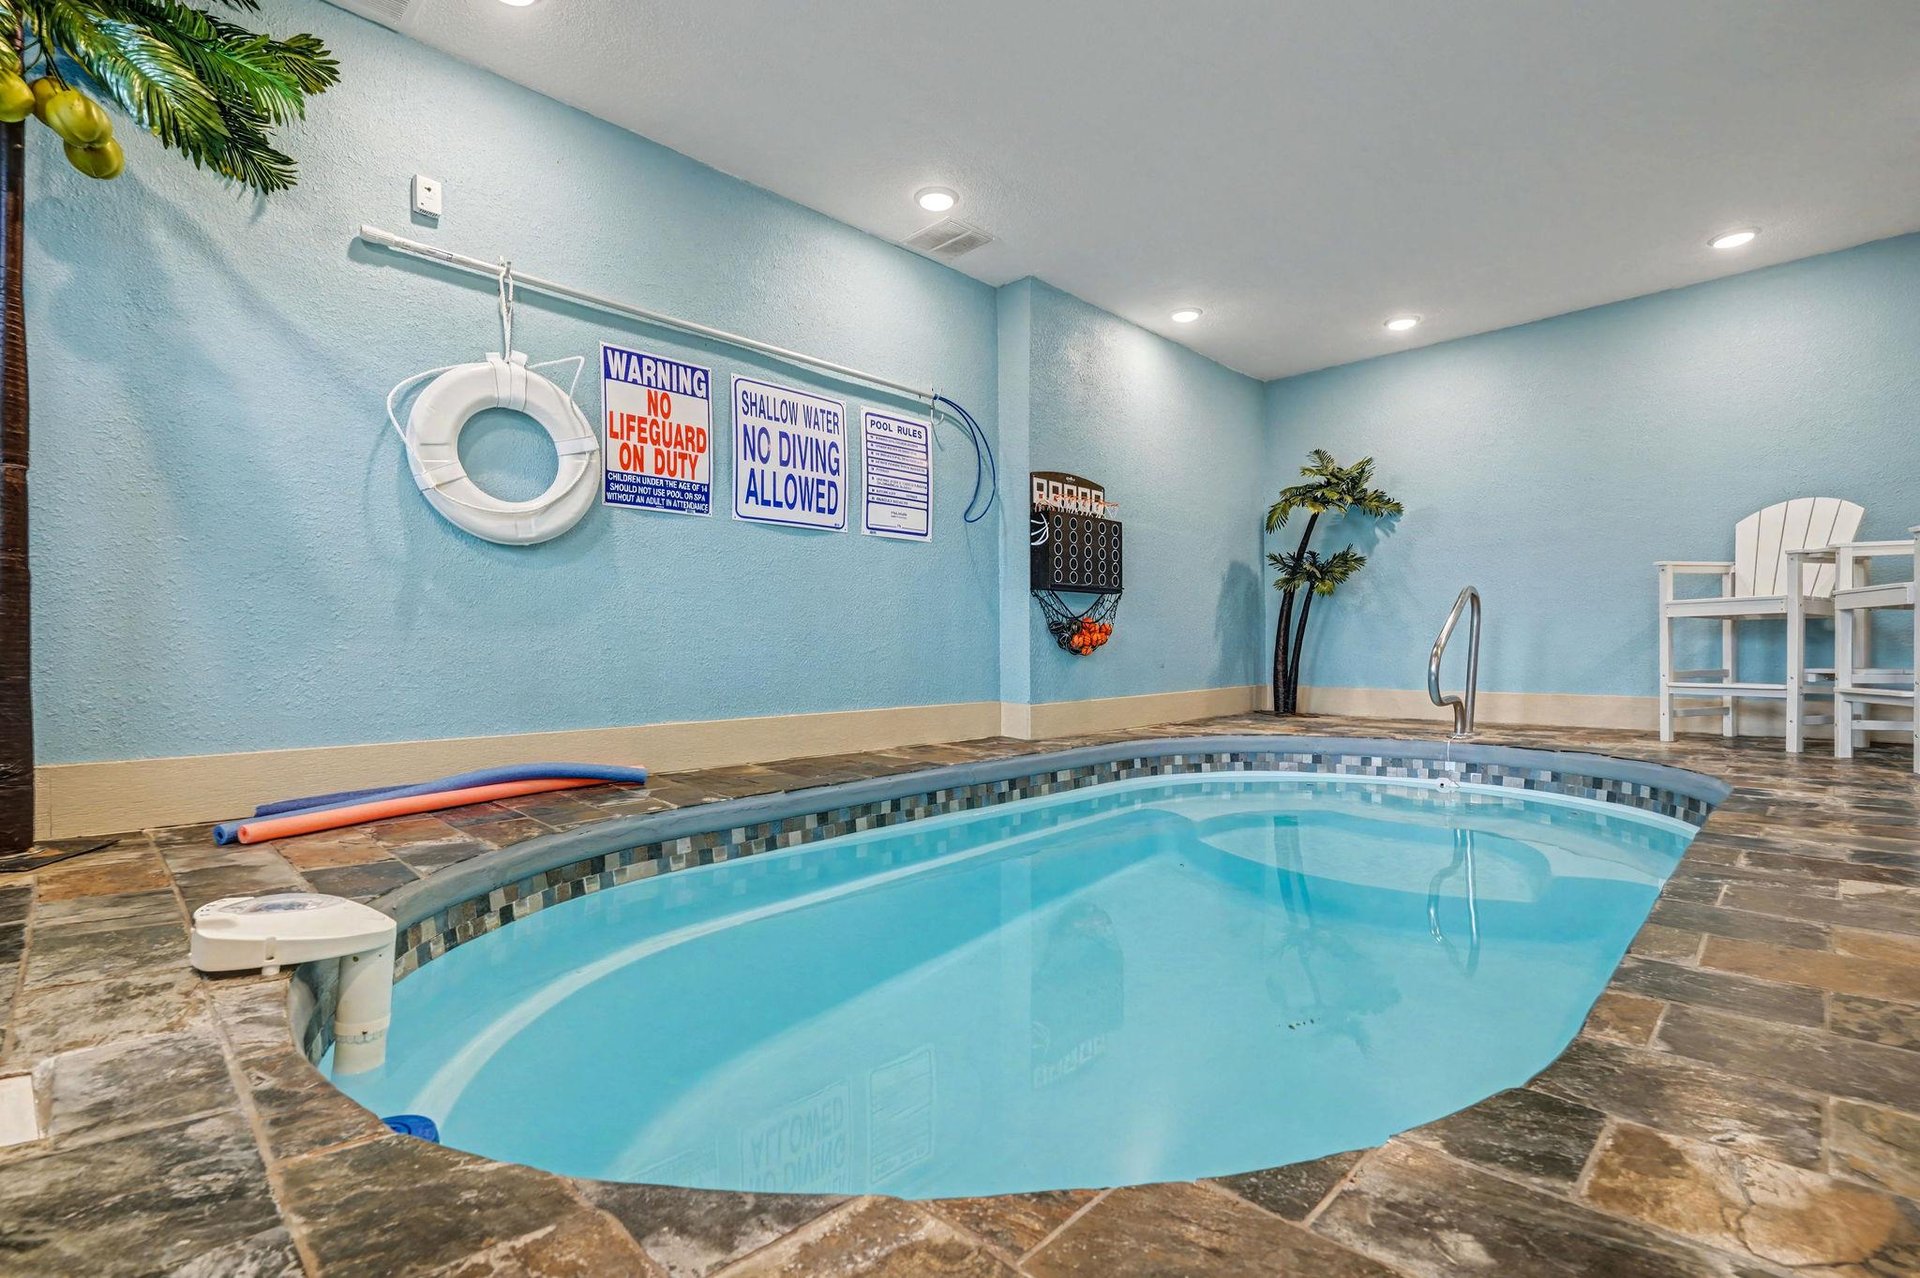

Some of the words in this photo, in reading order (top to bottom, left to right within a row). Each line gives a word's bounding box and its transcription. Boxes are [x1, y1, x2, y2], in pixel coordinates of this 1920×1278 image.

[607, 350, 706, 398] WARNING
[647, 389, 672, 419] NO
[742, 390, 798, 425] SHALLOW
[803, 404, 840, 435] WATER
[609, 411, 707, 453] LIFEGUARD
[871, 420, 893, 432] POOL
[898, 426, 922, 439] RULES
[619, 443, 644, 472] ON
[655, 448, 699, 480] DUTY
[743, 424, 771, 465] NO
[779, 431, 840, 476] DIVING
[608, 473, 641, 483] CHILDREN
[642, 477, 663, 487] UNDER
[665, 480, 677, 488] THE
[679, 482, 690, 490] AGE
[610, 483, 637, 493] SHOULD
[639, 486, 652, 495] NOT
[653, 488, 665, 497] USE
[667, 490, 683, 499] POOL
[684, 492, 693, 500] OR
[694, 494, 705, 502] SPA
[745, 468, 838, 515] ALLOWED
[607, 492, 635, 502] WITHOUT
[636, 496, 644, 504] AN
[646, 497, 666, 505] ADULT
[673, 500, 708, 511] ATTENDANCE
